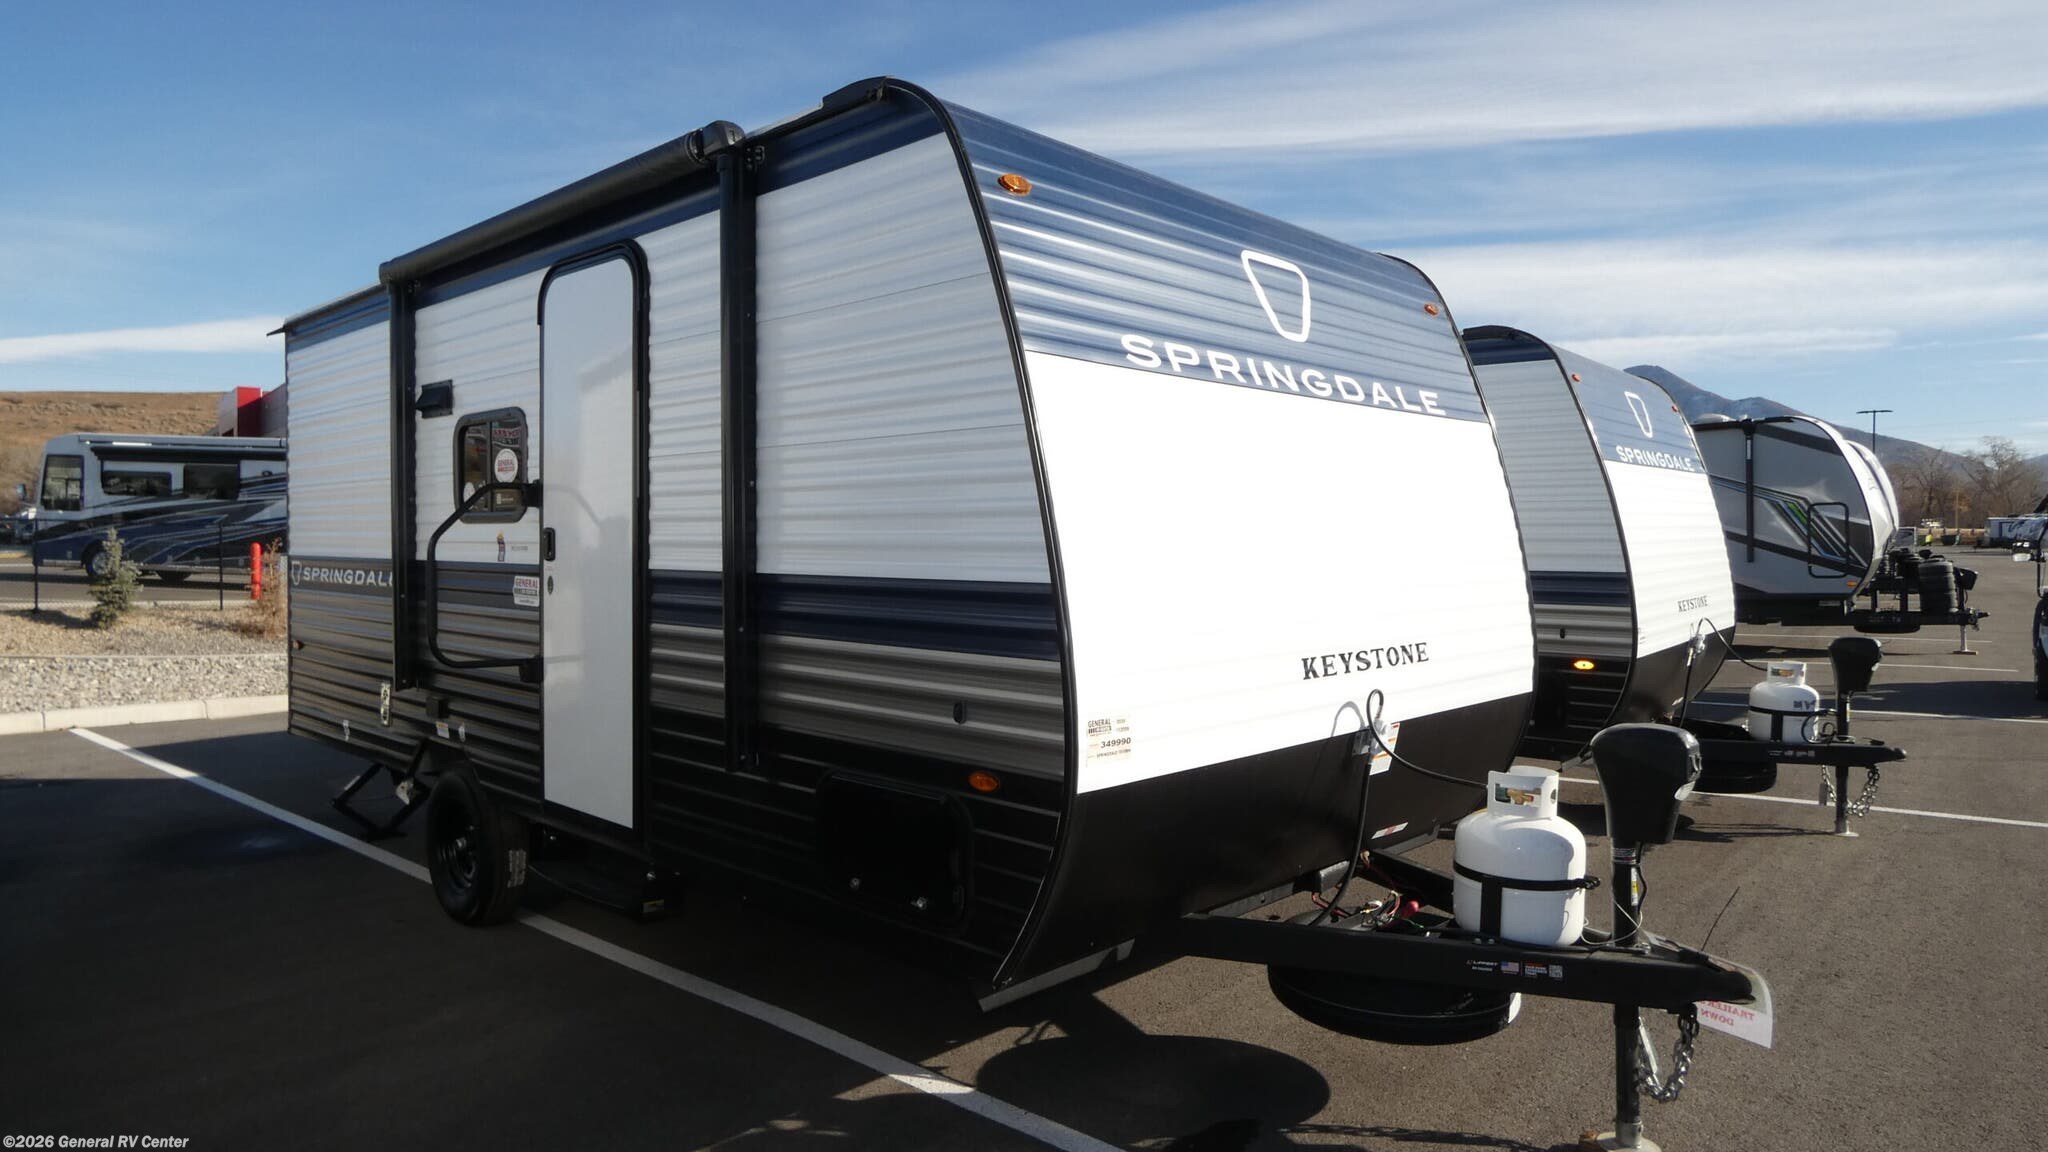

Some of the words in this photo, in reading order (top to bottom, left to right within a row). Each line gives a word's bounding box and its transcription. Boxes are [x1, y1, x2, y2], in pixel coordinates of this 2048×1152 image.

[1121, 334, 1446, 415] SPRINGDALE
[1615, 445, 1695, 472] SPRINGDALE
[1301, 642, 1429, 680] KEYSTONE
[1088, 718, 1111, 728] GENERAL
[1101, 737, 1131, 748] 349990
